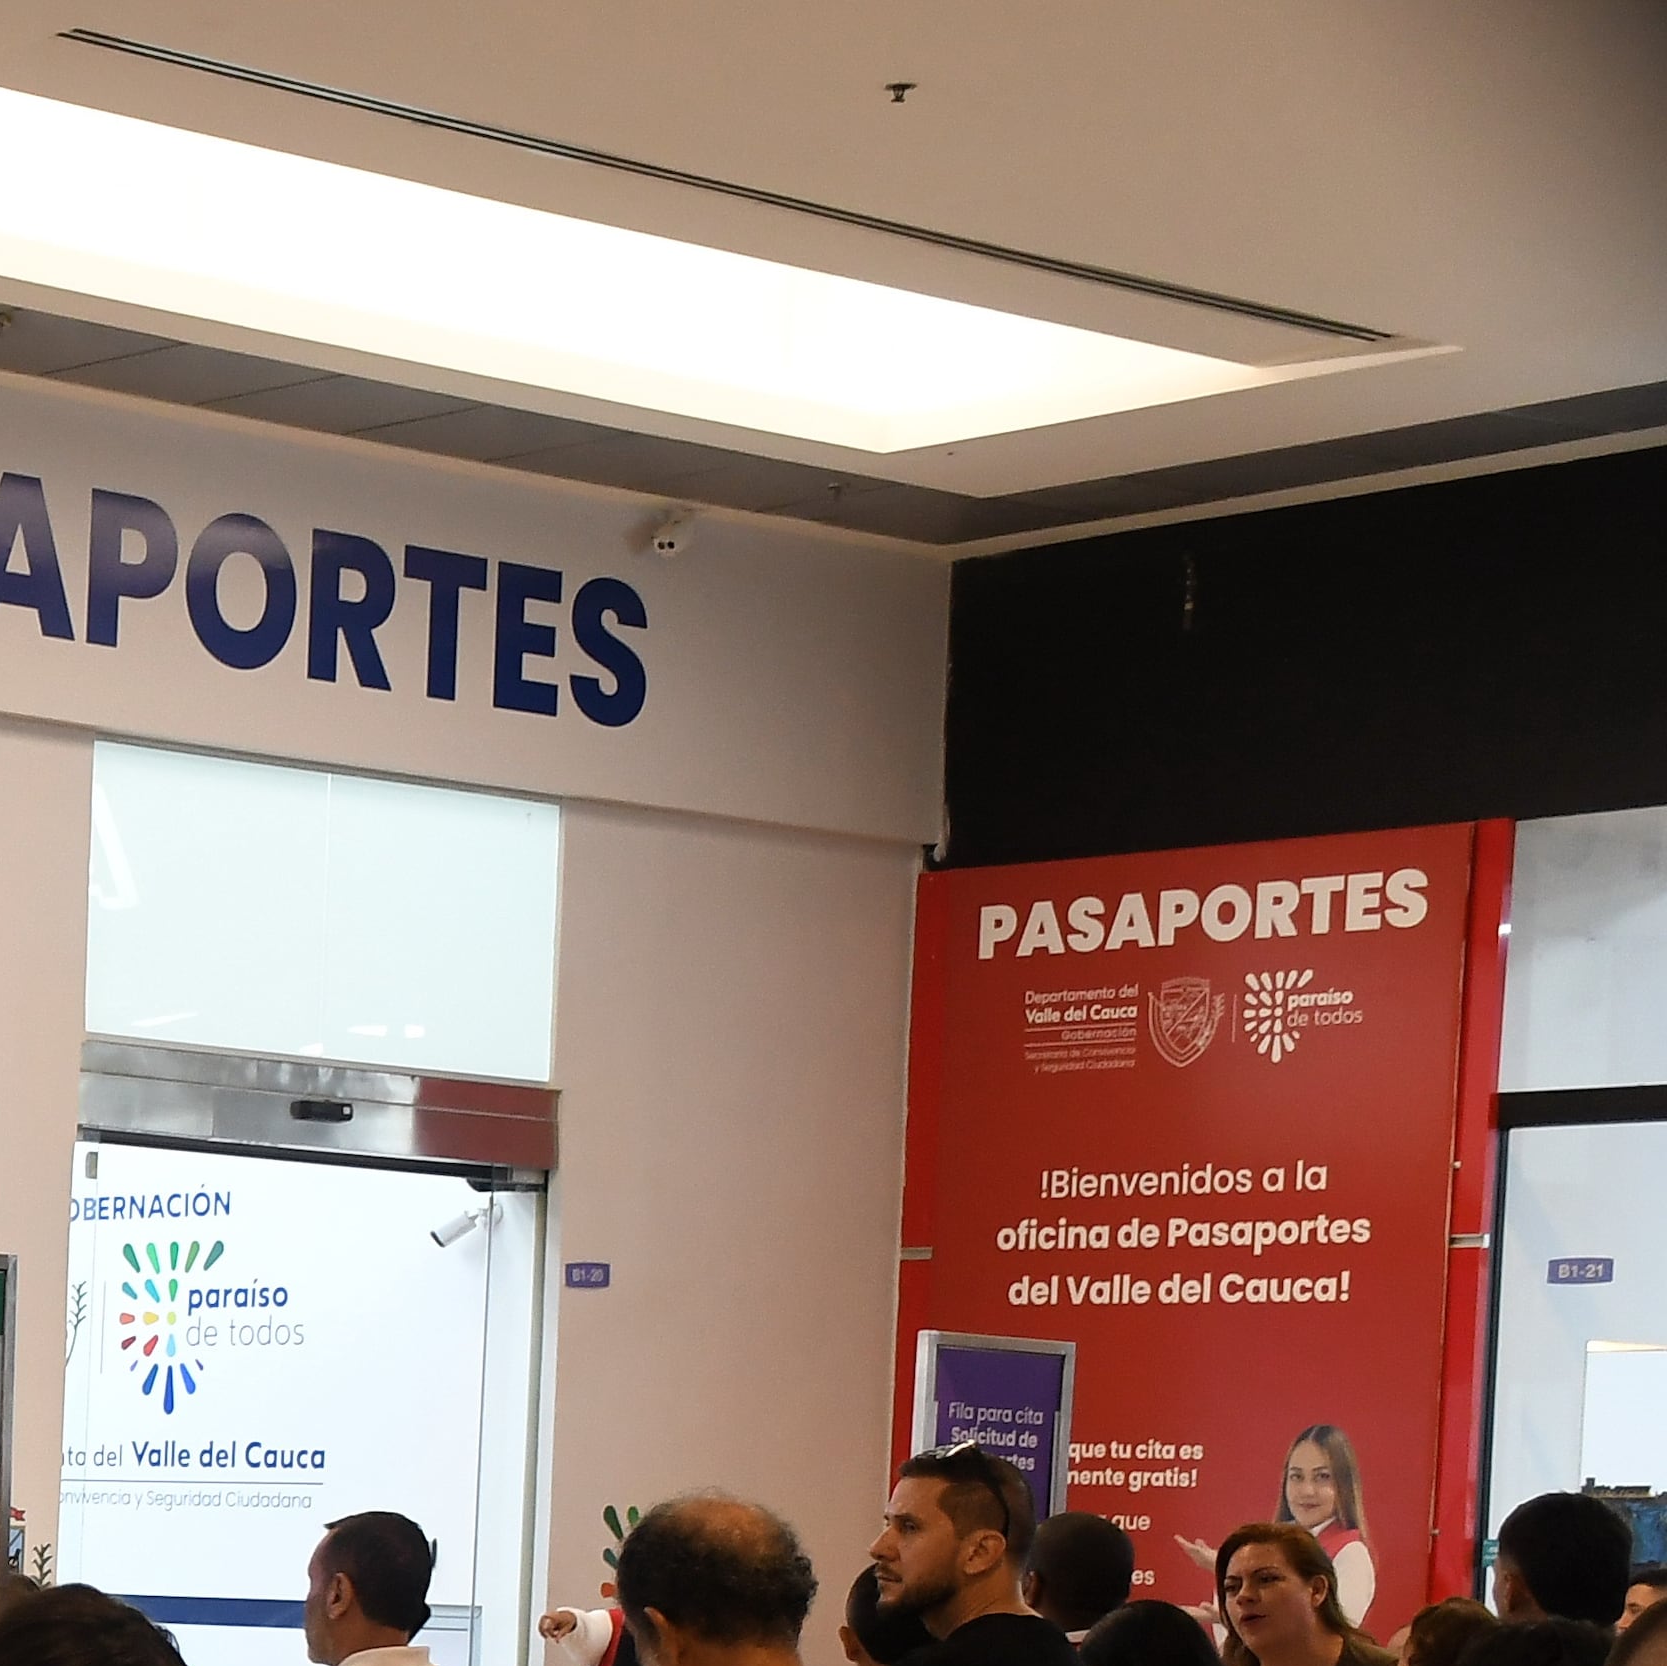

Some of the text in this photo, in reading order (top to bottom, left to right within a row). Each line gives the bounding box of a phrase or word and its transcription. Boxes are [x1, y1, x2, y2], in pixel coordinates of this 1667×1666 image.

[978, 867, 1429, 959] PASAPORTES
[1025, 983, 1139, 1005] Departamento del
[1287, 987, 1353, 1011] paraíso
[1026, 1004, 1137, 1024] Valle del Cauca
[1287, 1006, 1363, 1027] de todos
[1061, 1026, 1137, 1041] Gobernación
[1039, 1160, 1328, 1200] !Bienvenidos a la
[69, 1183, 231, 1222] OBERNACIÓN
[996, 1215, 1372, 1256] oficina de Pasaportes
[1558, 1263, 1605, 1279] B1-21
[187, 1278, 289, 1317] paraíso
[1007, 1269, 1351, 1306] del Valle del Cauca!
[185, 1314, 305, 1347] de todos
[948, 1401, 1044, 1426] Fila para cita
[950, 1426, 1038, 1448] Solicitud de
[93, 1443, 123, 1468] del
[131, 1440, 191, 1468] Valle
[199, 1440, 237, 1468] del
[245, 1441, 326, 1469] Cauca
[1069, 1438, 1204, 1464] que tu cita es
[1128, 1467, 1198, 1492] gratis!
[60, 1489, 313, 1512] onvivencia y Seguridad Ciudadana
[1111, 1513, 1152, 1531] que
